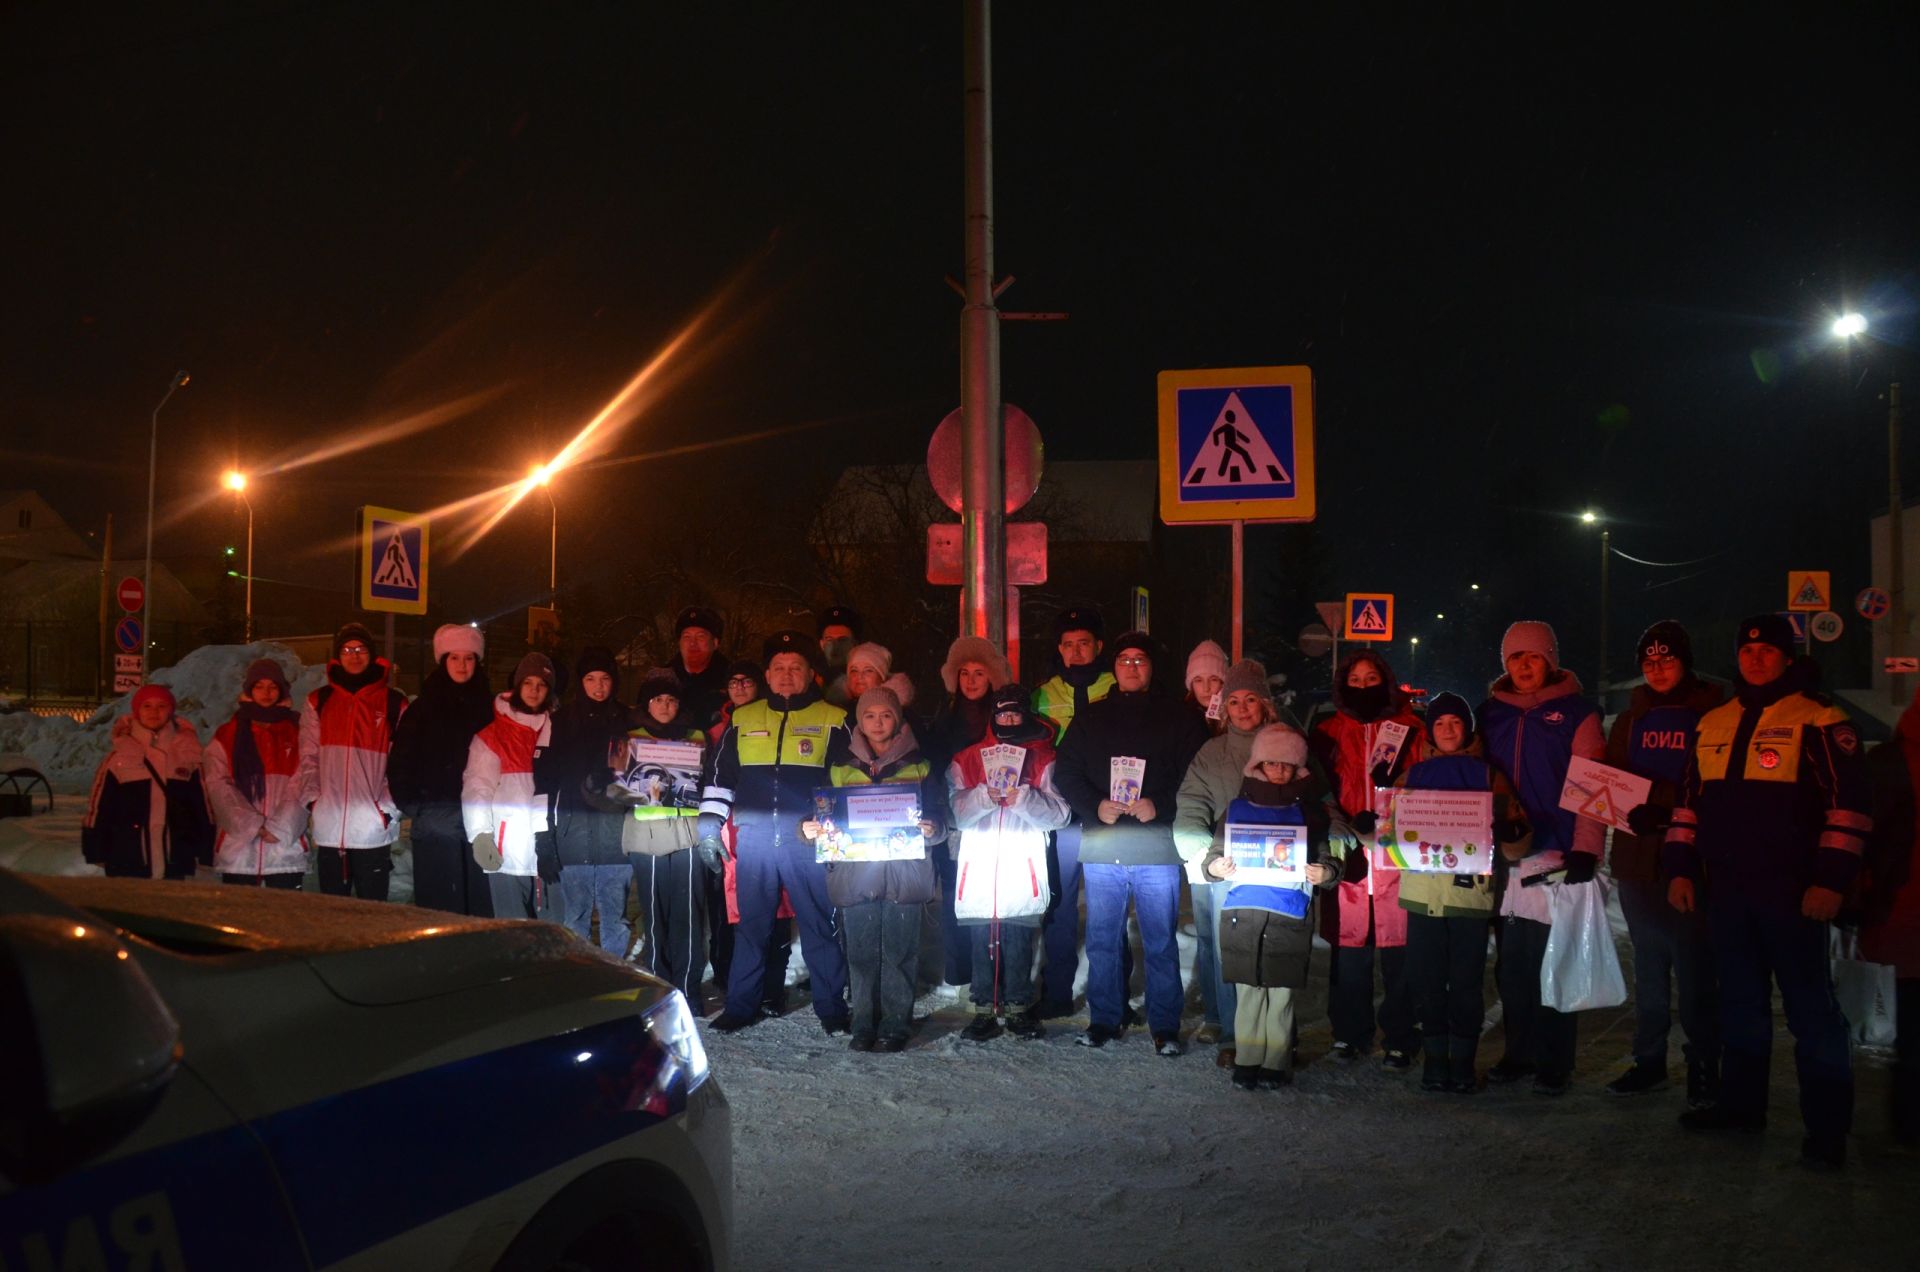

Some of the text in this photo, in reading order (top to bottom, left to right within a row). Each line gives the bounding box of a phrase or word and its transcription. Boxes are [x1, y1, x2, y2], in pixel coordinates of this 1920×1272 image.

[1818, 621, 1836, 633] 40
[1646, 640, 1669, 656] alo
[1642, 731, 1686, 750] ЮИД
